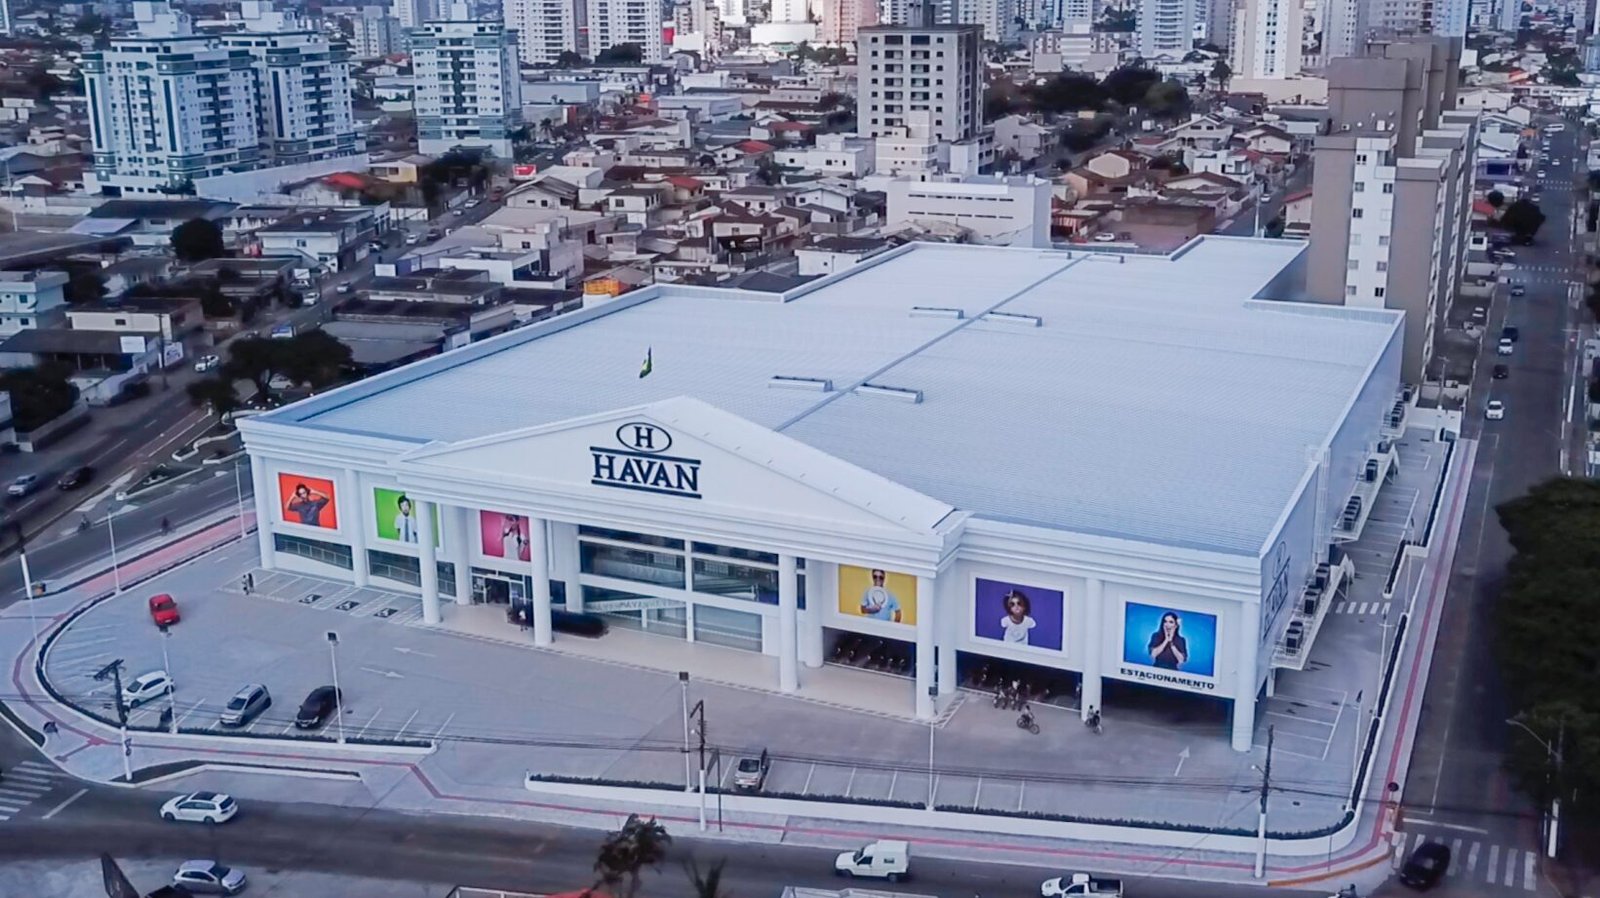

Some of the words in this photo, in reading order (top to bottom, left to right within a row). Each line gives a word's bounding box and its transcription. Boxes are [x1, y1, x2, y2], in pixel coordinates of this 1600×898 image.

[633, 425, 655, 449] H
[592, 453, 700, 492] HAVAN
[1120, 667, 1215, 690] ESTACIONAMENTO
